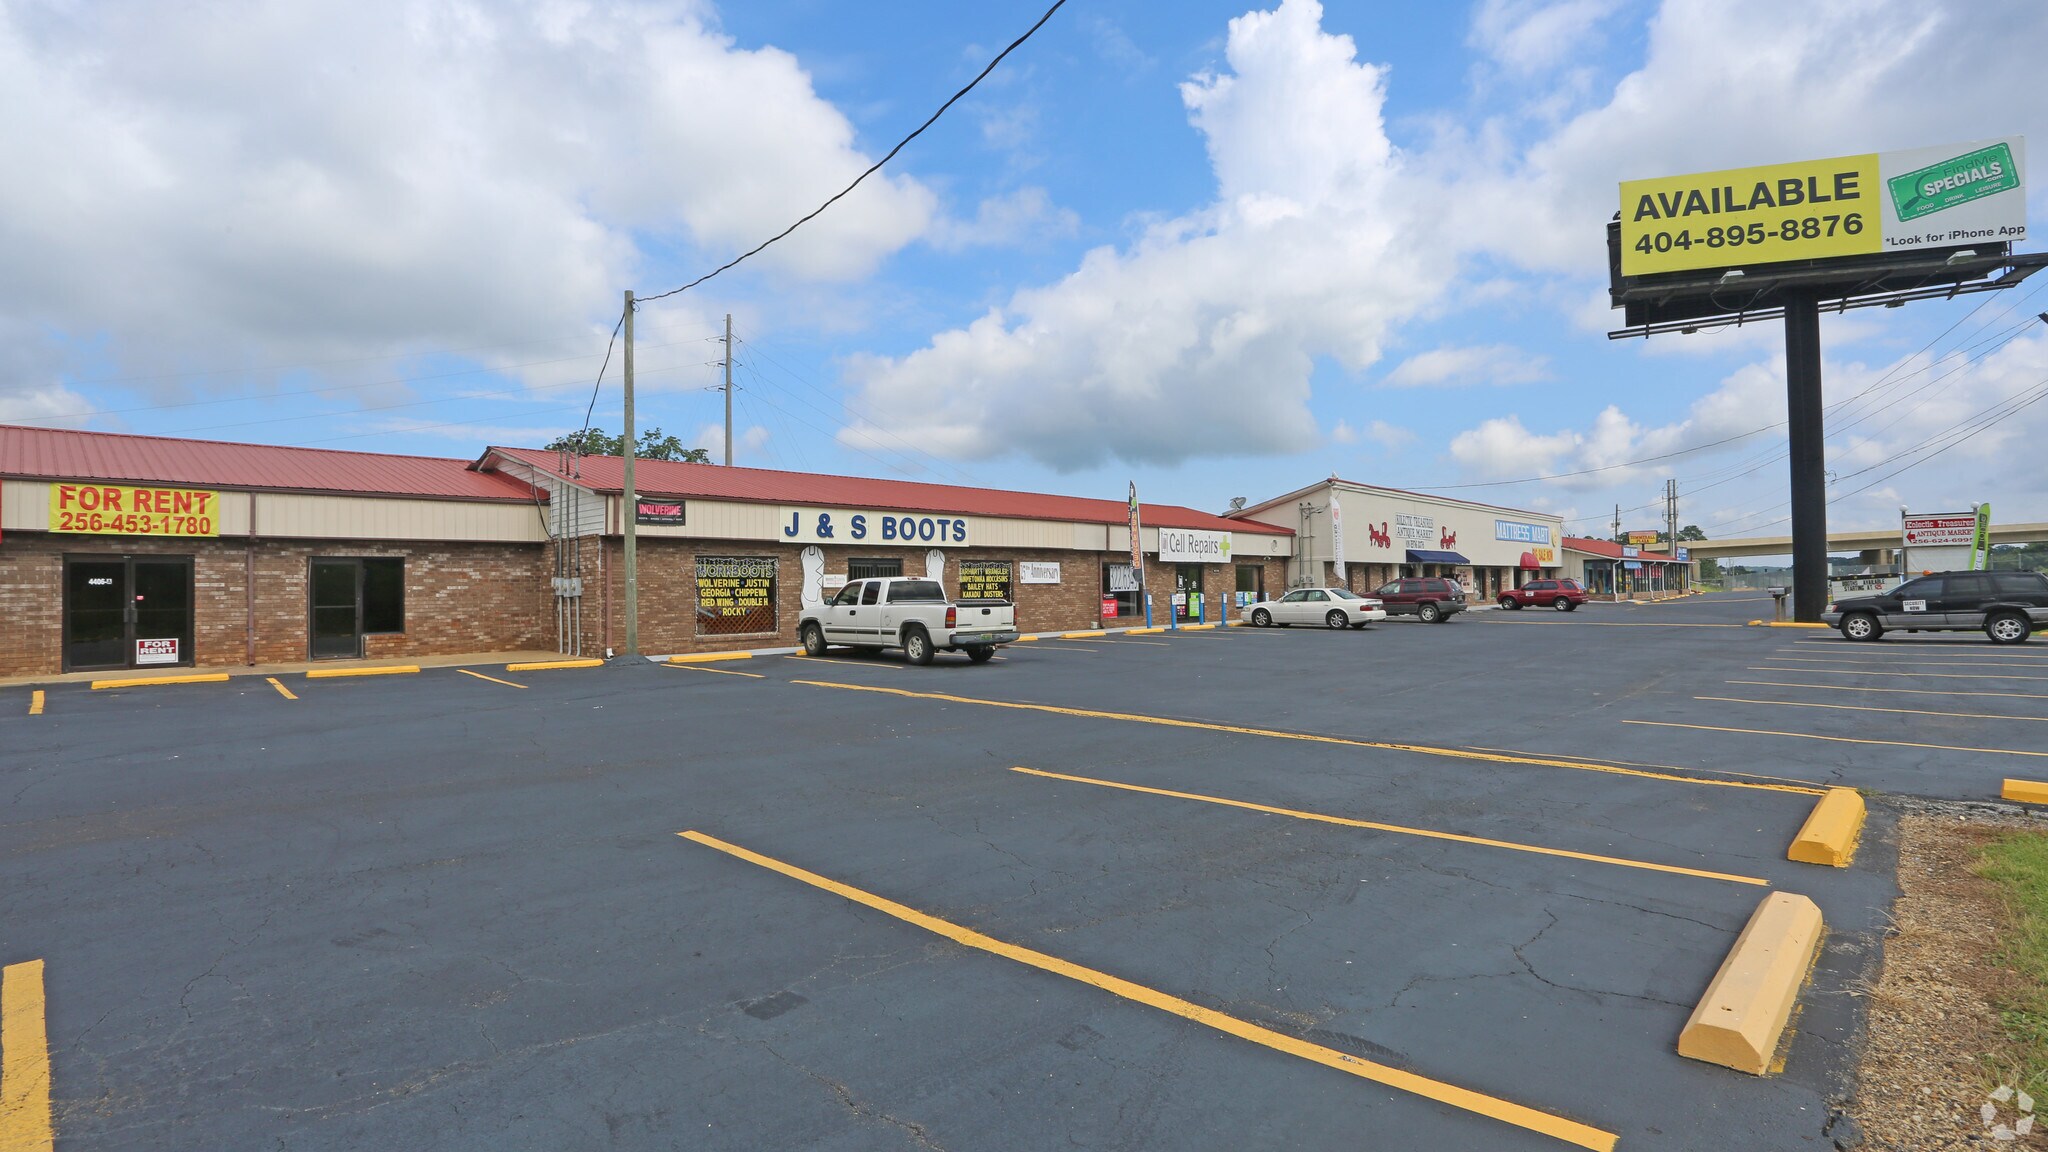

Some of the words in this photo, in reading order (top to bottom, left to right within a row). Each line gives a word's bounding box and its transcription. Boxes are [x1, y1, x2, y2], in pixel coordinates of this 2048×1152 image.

[1944, 154, 1998, 176] FindMe
[1923, 162, 2002, 196] SPECIALS
[1633, 171, 1861, 222] AVAILABLE
[1916, 202, 1934, 212] FOOD
[1944, 193, 1965, 203] DRINK
[1974, 182, 2002, 194] LEISURE
[1635, 213, 1863, 255] 404-895-8876
[1926, 233, 1944, 243] for
[1948, 228, 1994, 240] iPhone
[1998, 226, 2026, 236] App
[59, 485, 123, 512] FOR
[133, 489, 212, 515] RENT
[638, 503, 682, 516] WOLVERINE
[59, 511, 211, 535] 256-453-1780
[784, 511, 800, 537] J
[816, 513, 835, 538] &
[851, 515, 867, 539] S
[882, 516, 966, 542] BOOTS
[1906, 521, 1934, 529] Eclectic
[1937, 519, 1975, 527] Treasures
[1496, 520, 1530, 541] MATTRESS
[1531, 526, 1549, 543] MART
[1916, 530, 1946, 538] ANTIQUE
[1169, 532, 1185, 553] Cell
[1188, 534, 1219, 559] Repairs
[696, 564, 774, 578] WORKBOOTS
[697, 578, 740, 588] WOLVERINE
[744, 578, 770, 588] JUSTIN
[1863, 578, 1886, 586] AVAILABLE
[700, 588, 731, 597] GEORGIA
[734, 588, 768, 597] CHIPPEWA
[983, 590, 1004, 598] DUSTERS
[701, 598, 716, 607] RED
[716, 598, 734, 607] WING
[738, 597, 763, 606] DOUBLE
[763, 597, 769, 606] H
[722, 607, 746, 616] ROCKY
[144, 640, 171, 648] FOR
